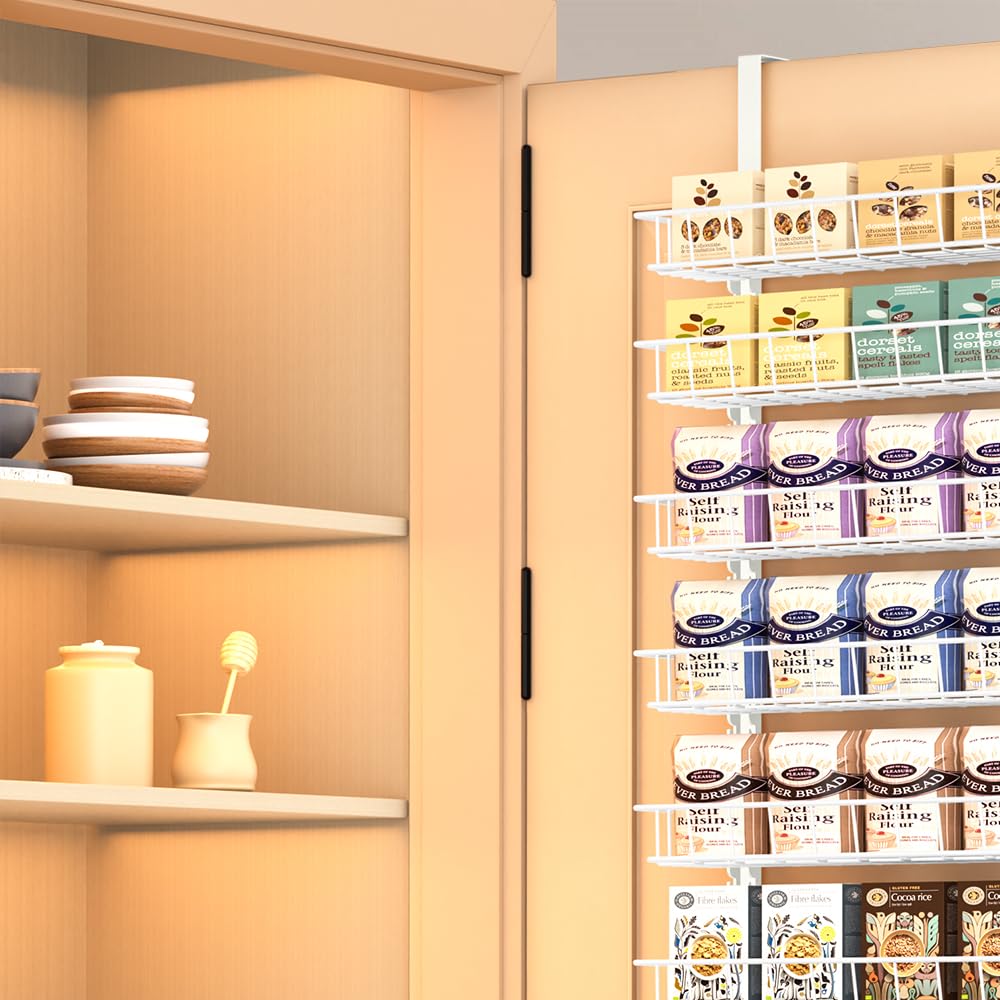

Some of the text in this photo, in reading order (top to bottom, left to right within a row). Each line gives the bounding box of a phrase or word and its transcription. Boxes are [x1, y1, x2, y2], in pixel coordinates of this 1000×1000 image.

[857, 335, 915, 347] dorset
[857, 344, 922, 356] cereals
[764, 361, 802, 369] cassic
[671, 372, 712, 380] roated
[796, 464, 847, 486] BREAD
[893, 458, 945, 480] BREAD
[700, 469, 752, 491] BREAD
[689, 497, 720, 506] Self
[869, 496, 932, 506] Raiing
[700, 624, 751, 646] BREAD
[796, 620, 847, 641] BREAD
[893, 615, 945, 637] BREAD
[700, 779, 751, 801] BREAD
[796, 776, 847, 798] BREAD
[893, 773, 945, 795] BREAD
[891, 893, 932, 902] Cocoa rice
